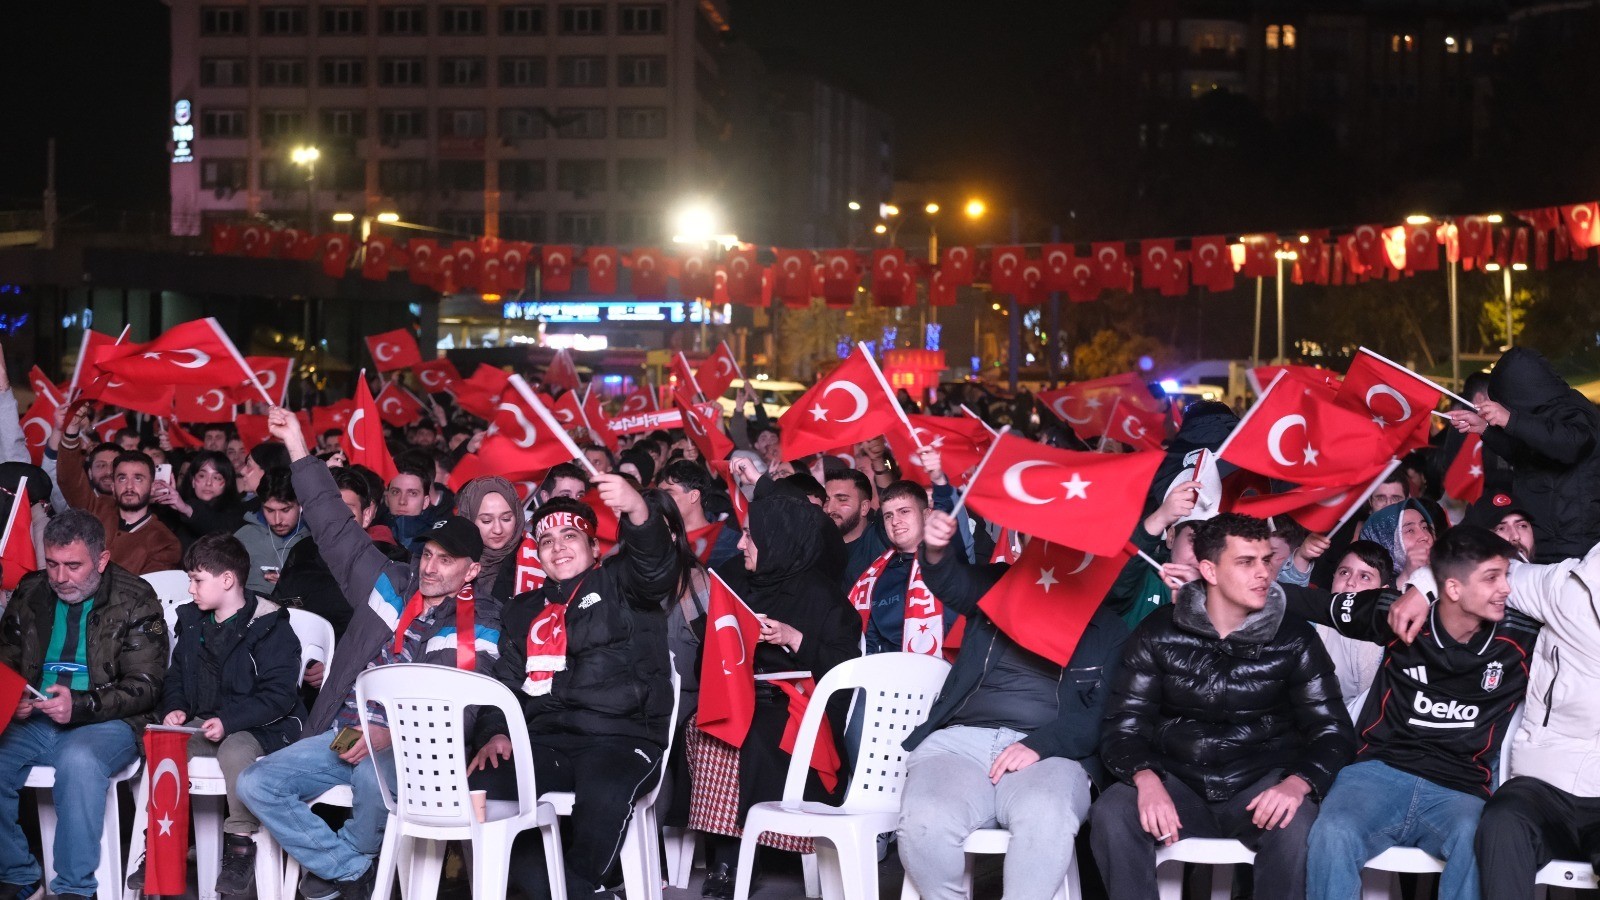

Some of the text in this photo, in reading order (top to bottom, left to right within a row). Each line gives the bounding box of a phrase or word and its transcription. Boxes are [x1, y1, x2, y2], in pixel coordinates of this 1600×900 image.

[536, 511, 573, 535] RKİYE
[1341, 592, 1357, 623] para
[1413, 691, 1479, 720] beko
